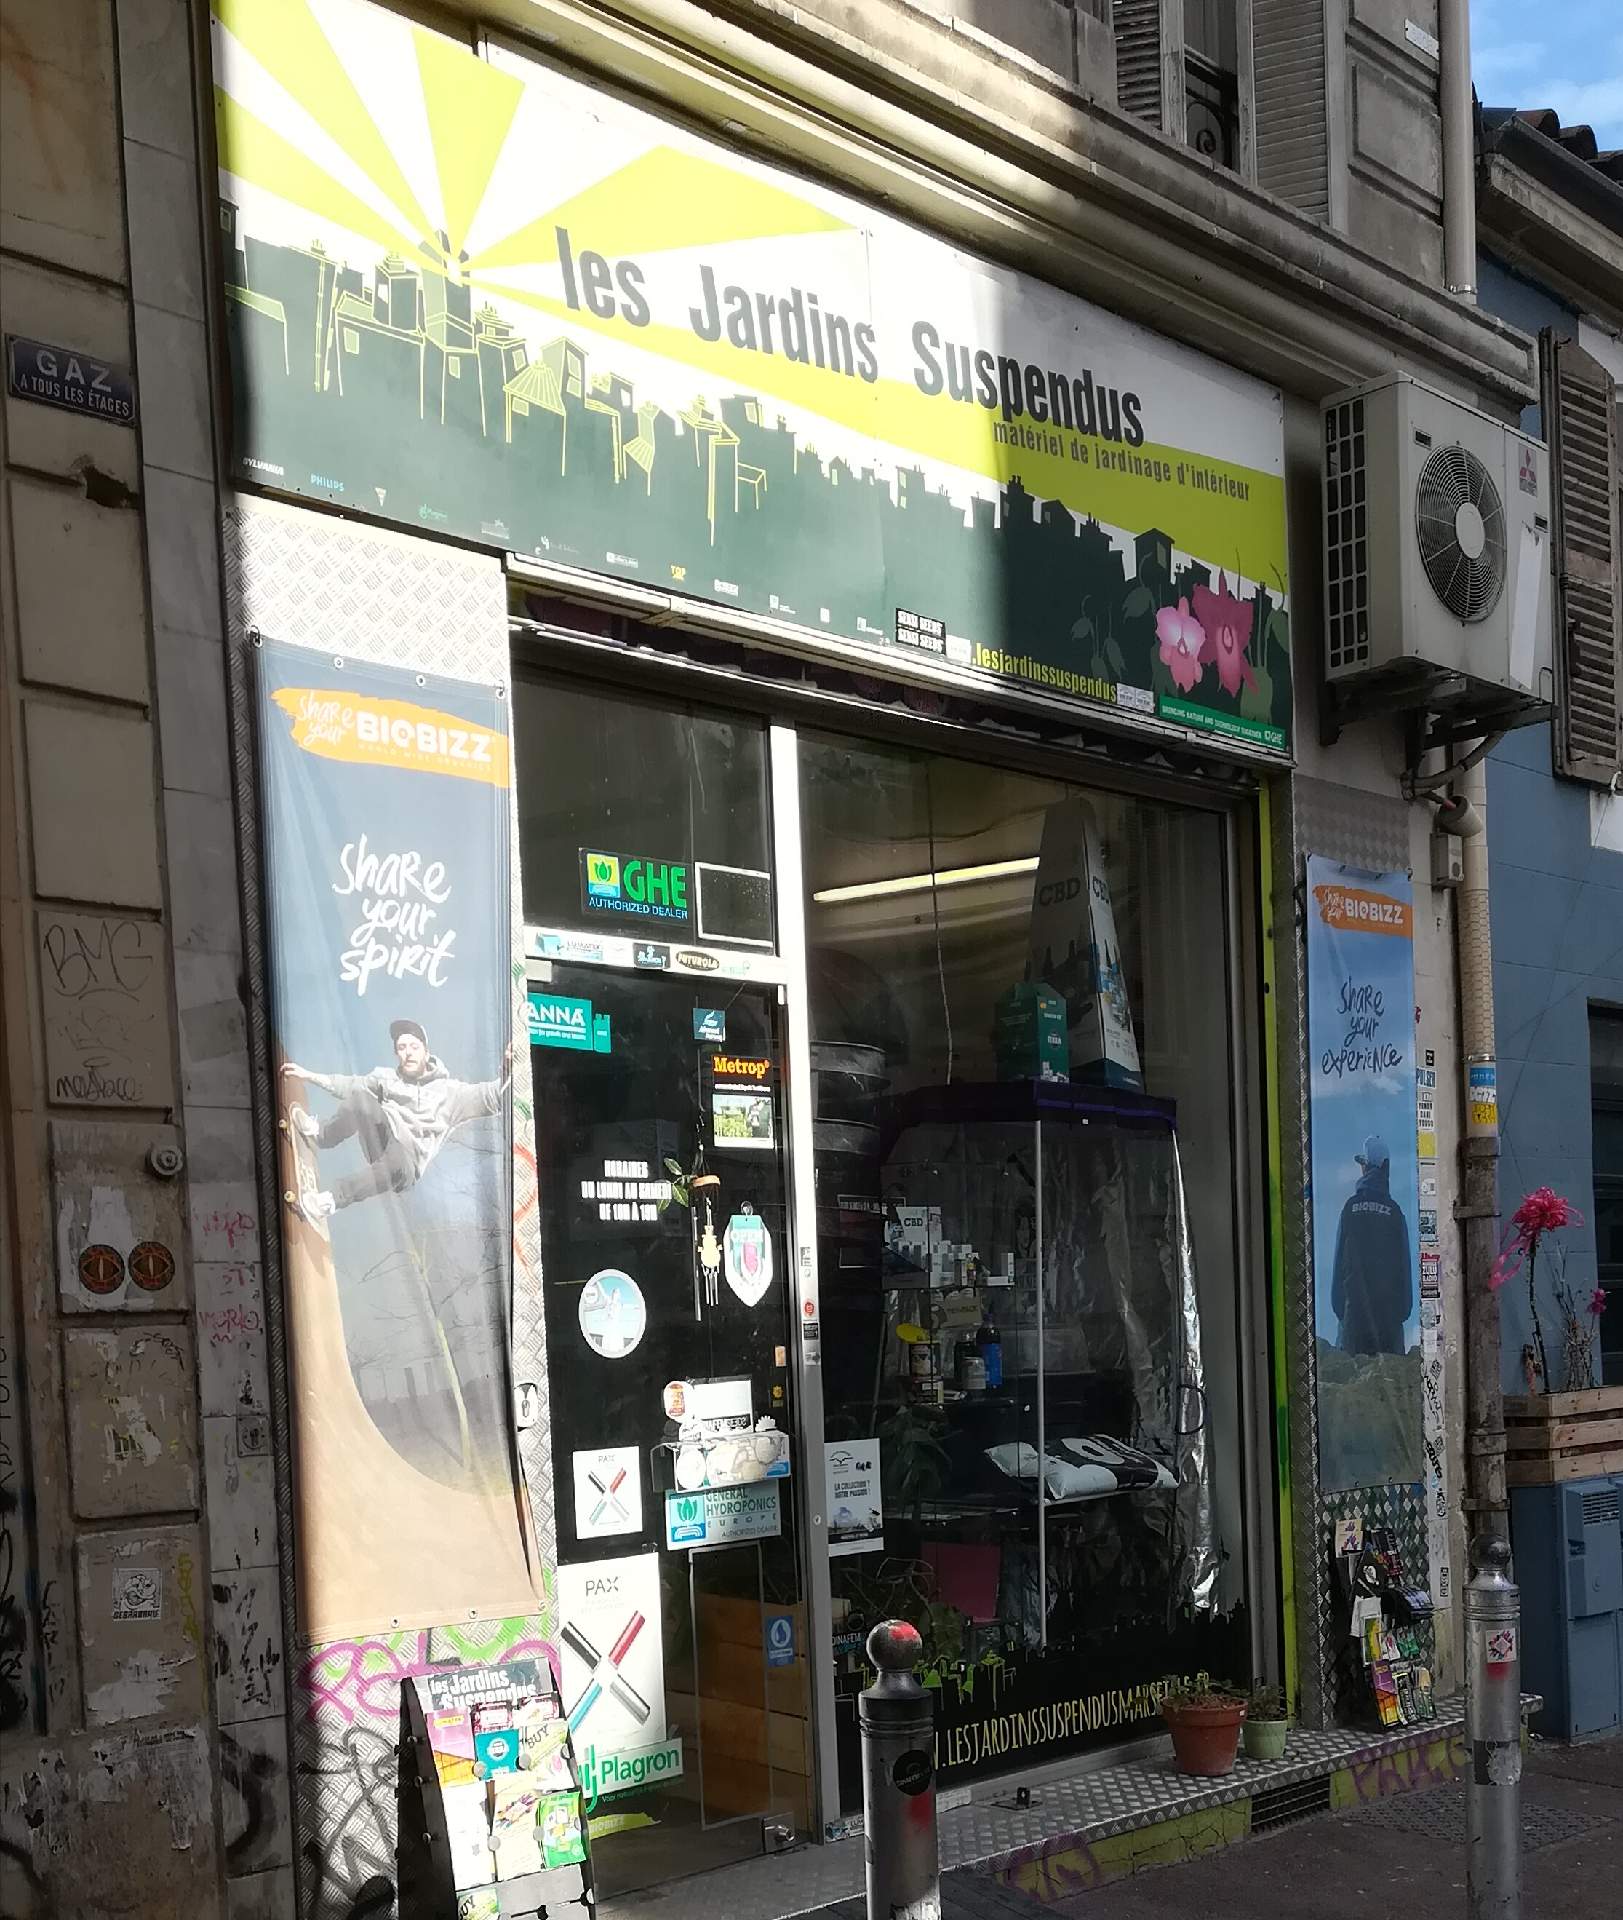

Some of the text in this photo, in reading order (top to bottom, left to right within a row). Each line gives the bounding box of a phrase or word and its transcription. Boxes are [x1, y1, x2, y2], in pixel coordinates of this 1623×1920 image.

[556, 225, 1145, 447] les Jardins Suspendus
[36, 349, 112, 392] GAZ
[31, 376, 61, 398] TOUS
[64, 385, 84, 403] LES
[88, 389, 130, 417] ÉTAGES
[243, 457, 285, 476] SYLVANIA
[993, 420, 1250, 501] matériel de jardinage d'intérieur
[310, 473, 345, 492] PHILIPS
[355, 711, 493, 763] BIOBIZZ
[623, 859, 688, 909] GHE
[1039, 876, 1081, 906] CBD
[588, 895, 688, 920] AUTHORIZED DEALER
[1345, 898, 1404, 924] BIOBIZZ
[350, 898, 437, 947] your
[528, 1000, 587, 1027] ANNA
[1344, 1016, 1380, 1047] your
[903, 1217, 924, 1229] CBD
[598, 1454, 616, 1464] PAX
[705, 1487, 748, 1502] GENERAL
[706, 1495, 777, 1516] HYDROPONICS
[585, 1576, 620, 1597] PAX
[449, 1668, 510, 1694] Jardins
[526, 1724, 550, 1750] BUY
[601, 1748, 681, 1786] Plagron
